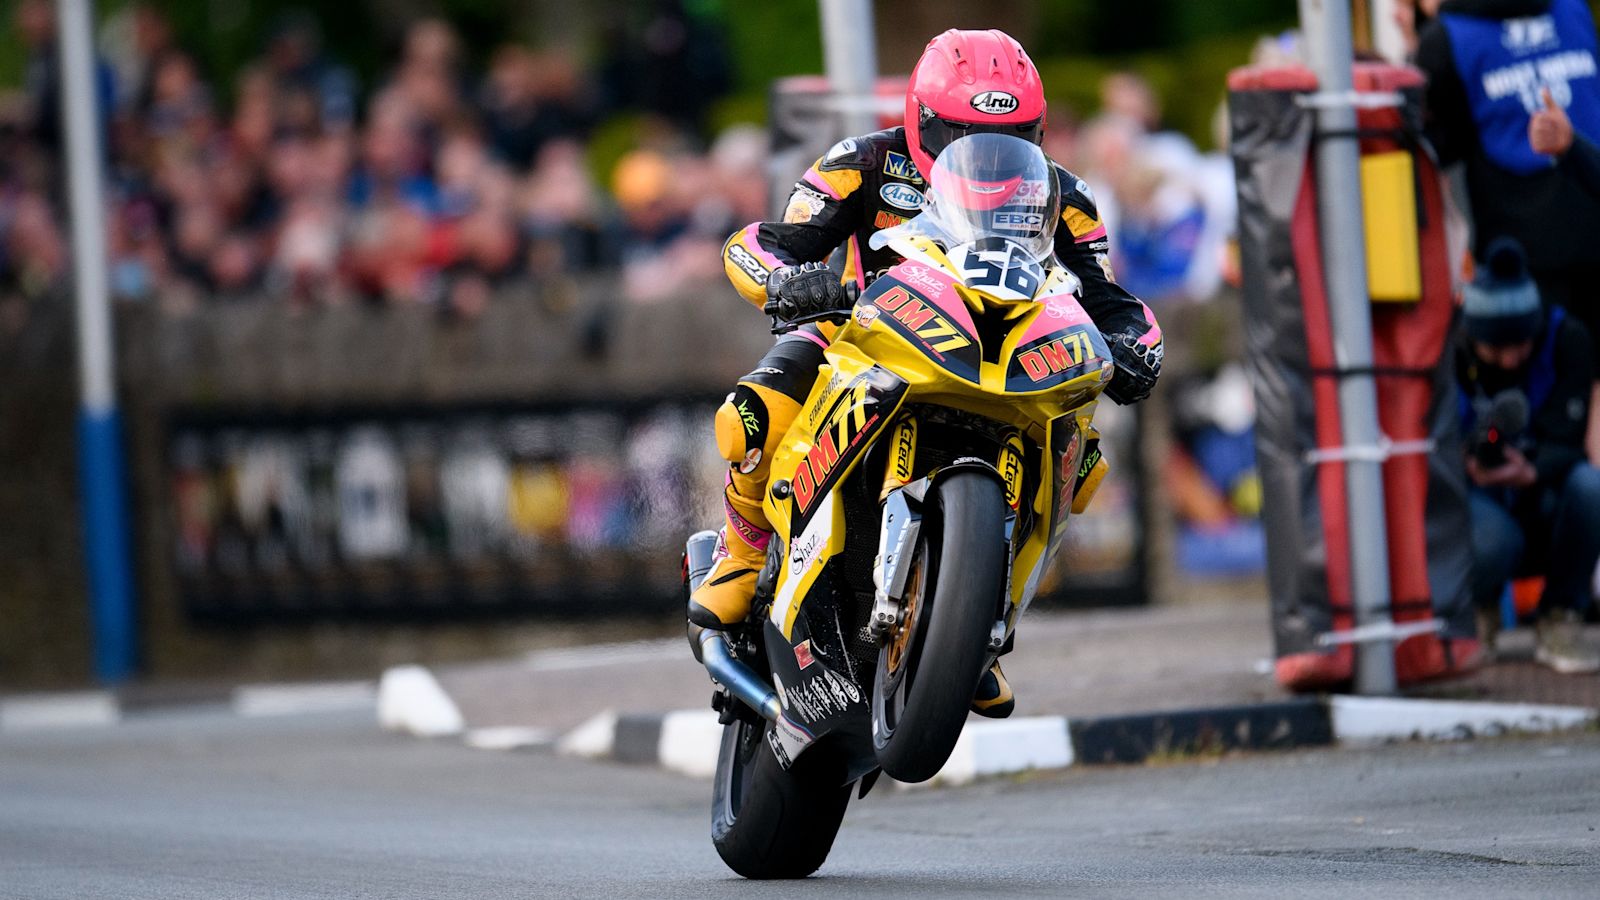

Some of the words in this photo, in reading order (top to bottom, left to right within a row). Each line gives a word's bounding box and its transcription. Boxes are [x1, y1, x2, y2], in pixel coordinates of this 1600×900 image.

[972, 92, 1015, 108] Arai
[884, 186, 921, 205] Arai
[994, 213, 1041, 225] EBC
[964, 237, 1040, 301] 56
[873, 285, 972, 353] DM71
[1017, 332, 1096, 383] DM71
[792, 377, 867, 514] DM71
[792, 533, 820, 576] Shaz
